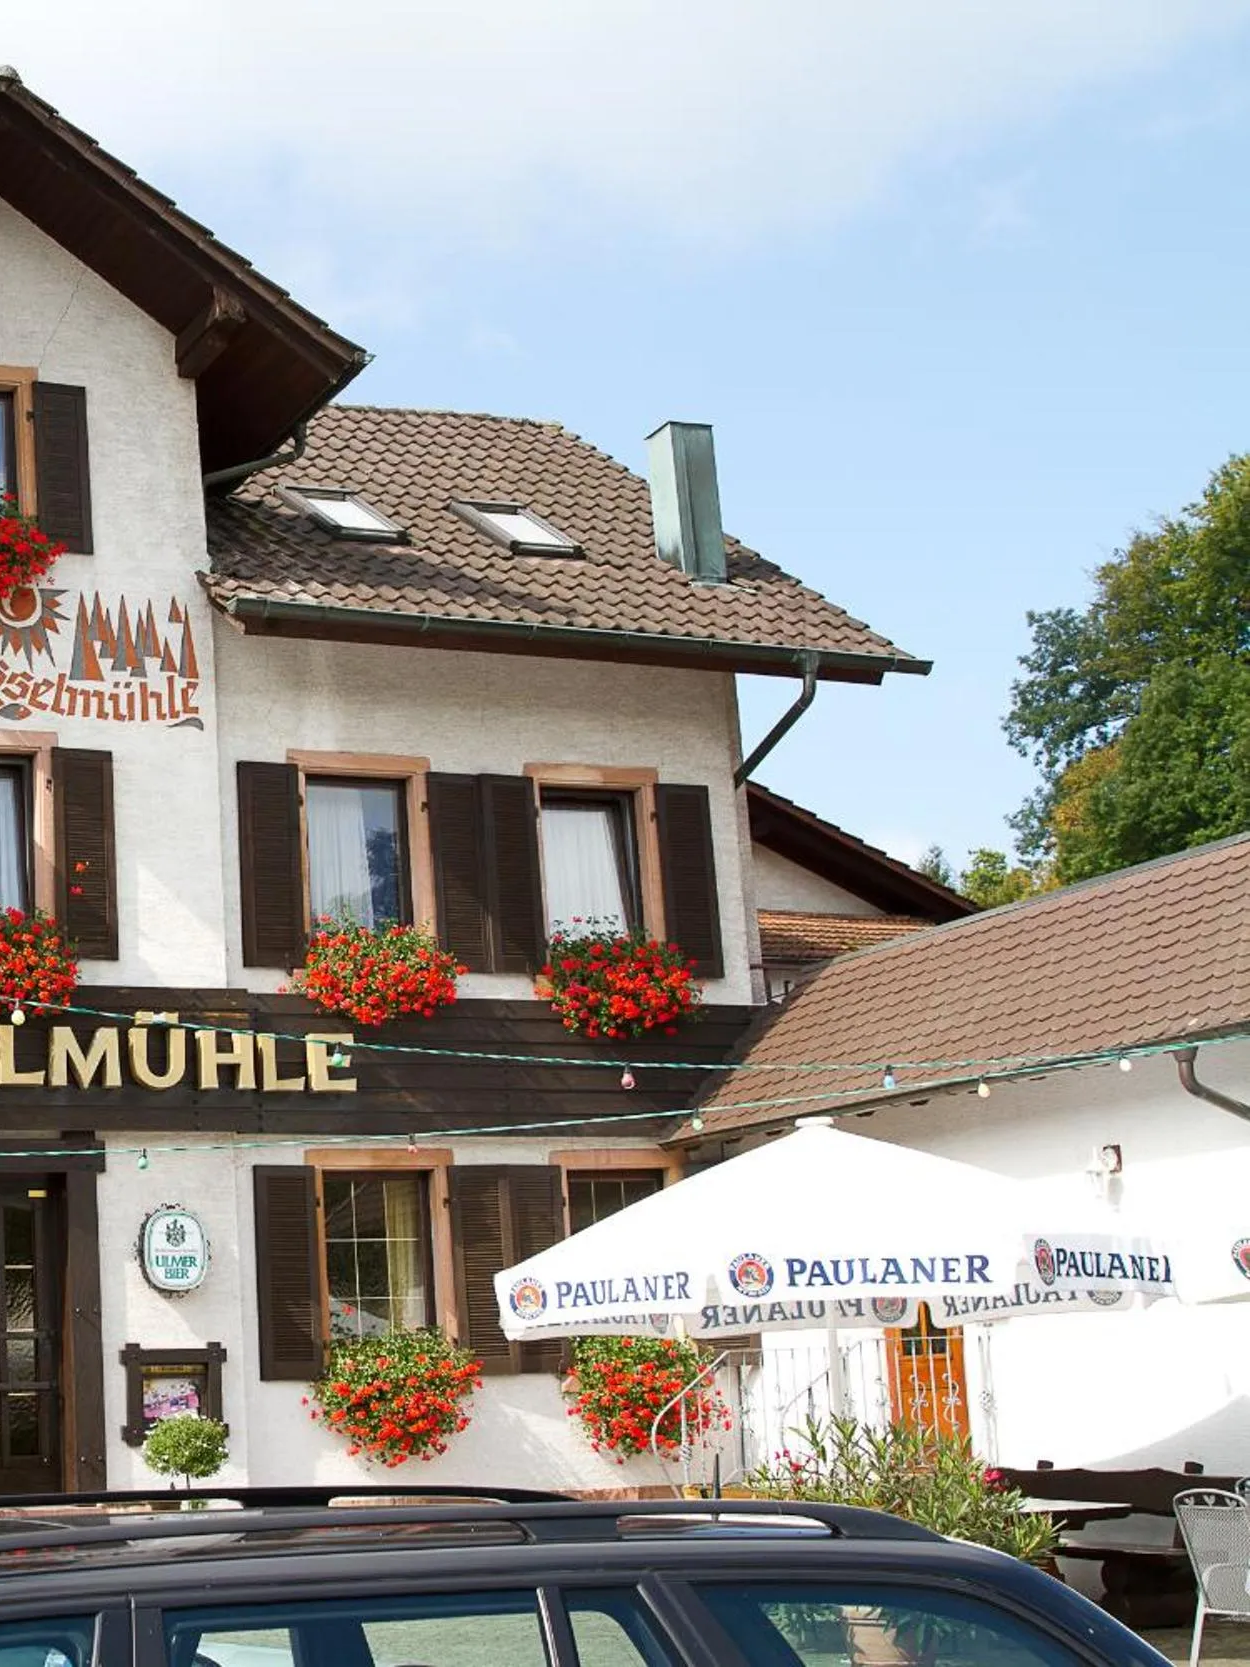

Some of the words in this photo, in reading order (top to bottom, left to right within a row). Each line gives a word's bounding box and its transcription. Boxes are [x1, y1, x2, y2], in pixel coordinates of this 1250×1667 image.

[155, 1255, 198, 1268] ULMER
[785, 1254, 994, 1287] PAULANER
[164, 1268, 190, 1280] BIER
[555, 1271, 692, 1309] PAULANER
